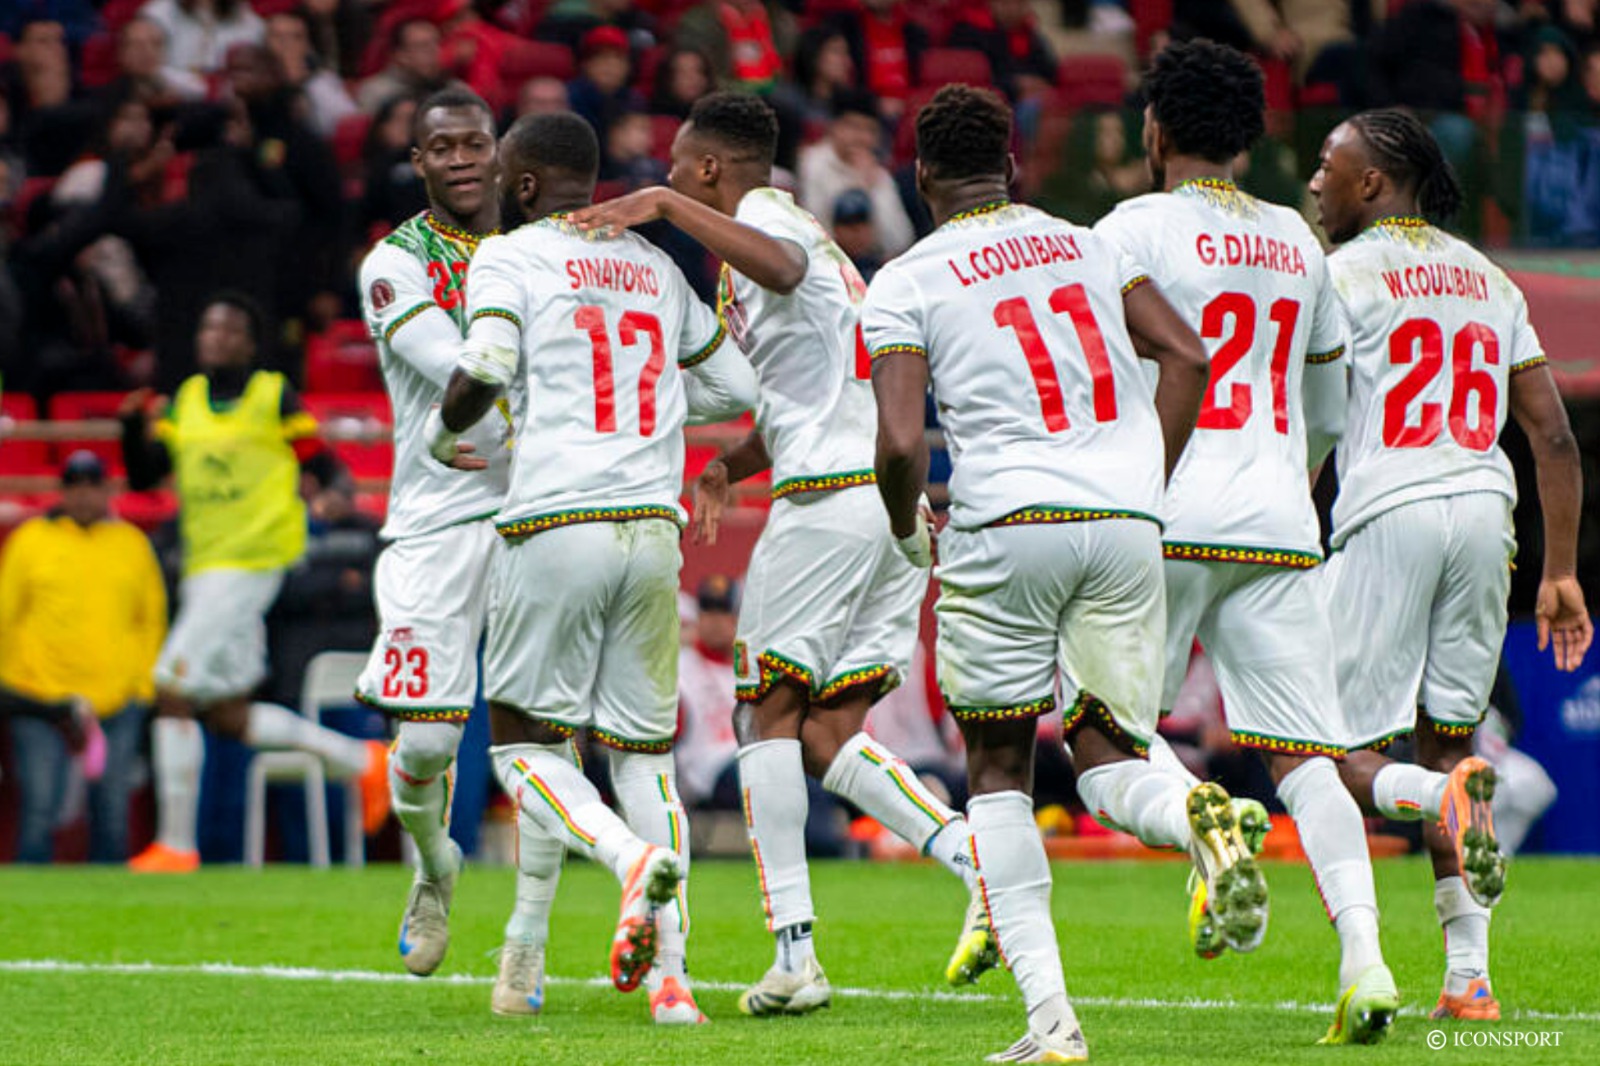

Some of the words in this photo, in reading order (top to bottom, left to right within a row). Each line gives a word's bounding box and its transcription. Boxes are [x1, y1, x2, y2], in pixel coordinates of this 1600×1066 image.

[565, 258, 660, 297] SINAYOKO
[948, 233, 1083, 287] L.COULIBALY
[1195, 233, 1306, 277] G.DIARRA
[1381, 263, 1488, 301] W.COULIBALY
[574, 305, 665, 437] 17
[992, 283, 1118, 435] 11
[1195, 291, 1301, 435] 21
[1382, 317, 1500, 452] 26
[381, 646, 429, 699] 23
